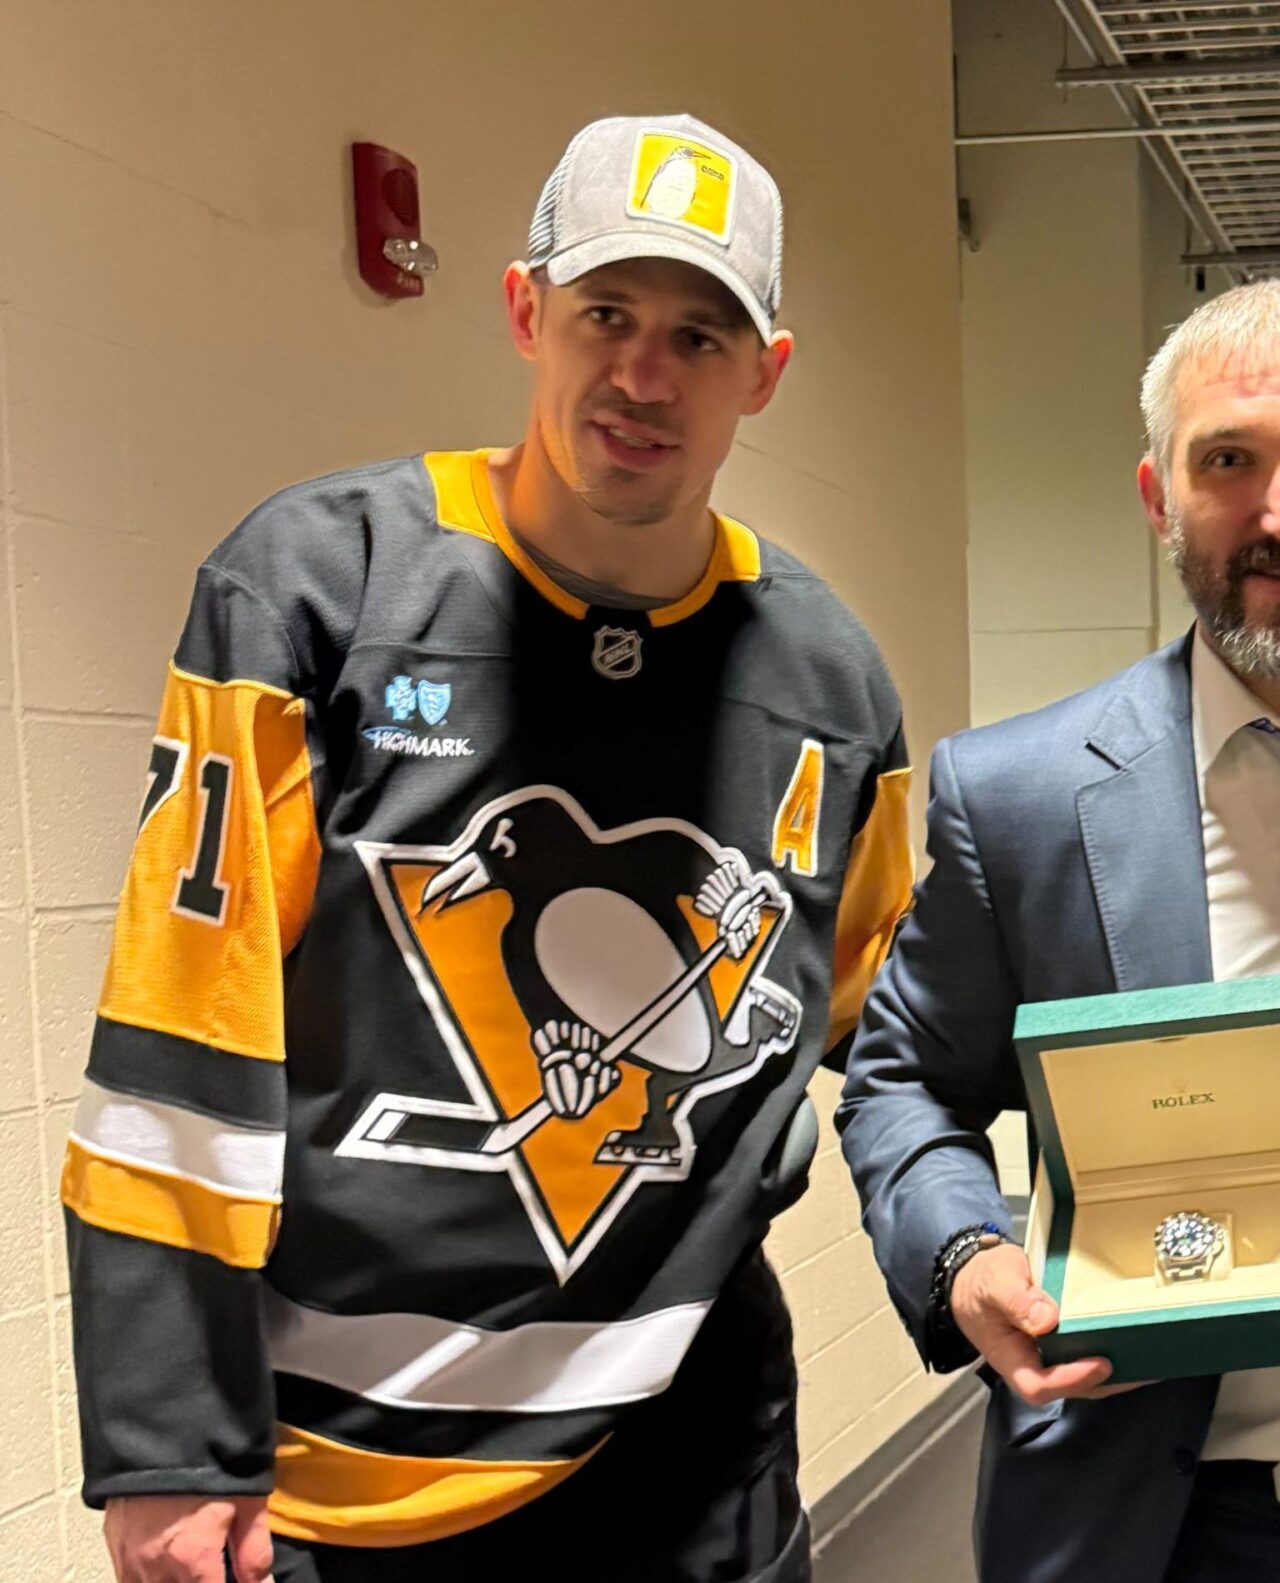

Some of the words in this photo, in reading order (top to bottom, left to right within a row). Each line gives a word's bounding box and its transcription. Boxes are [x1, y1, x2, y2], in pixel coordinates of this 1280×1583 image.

[136, 733, 234, 927] 71
[770, 738, 825, 878] A
[1151, 1091, 1215, 1110] ROLEX
